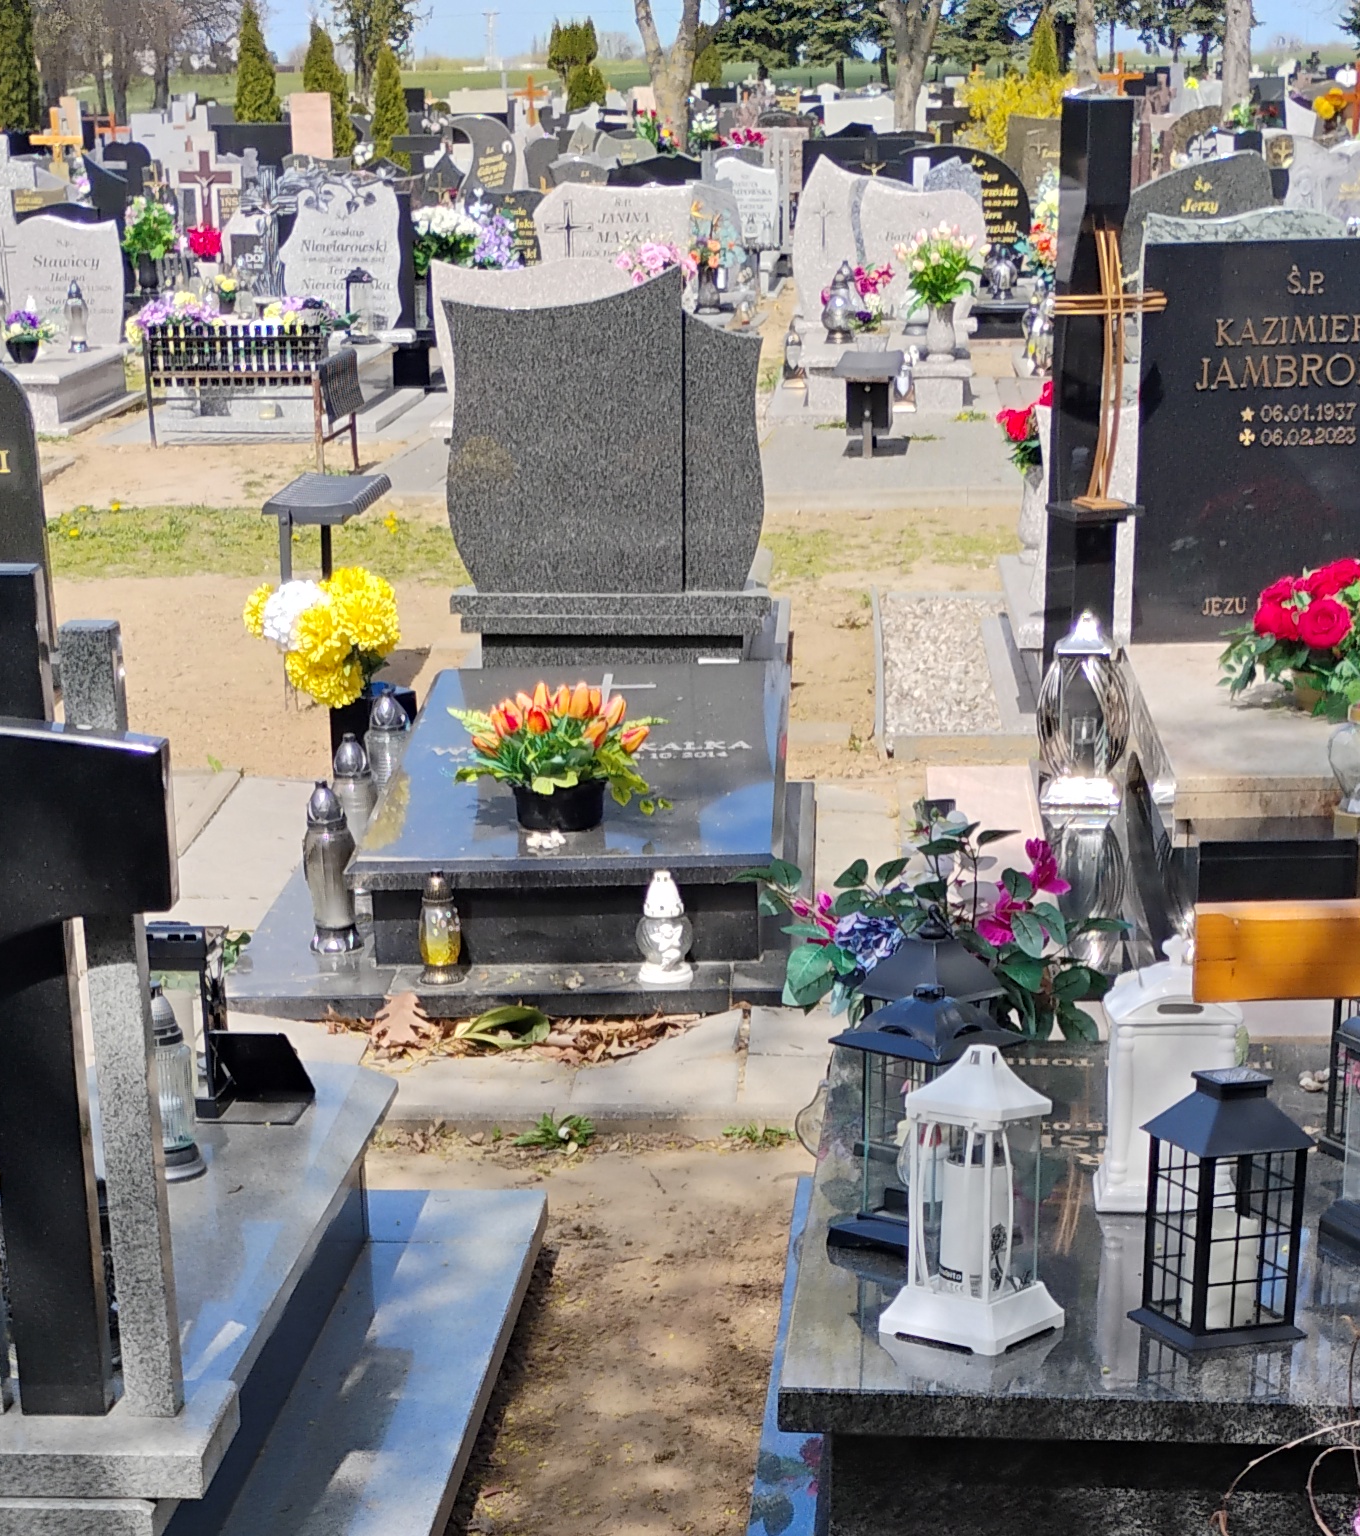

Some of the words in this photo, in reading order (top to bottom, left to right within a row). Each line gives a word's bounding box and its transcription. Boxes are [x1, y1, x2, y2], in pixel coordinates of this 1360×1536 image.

[1181, 198, 1219, 214] Jerzy
[1287, 265, 1326, 295] Ś.P.
[1260, 402, 1357, 422] 06.01.1937
[1260, 426, 1357, 446] 06.02.2023
